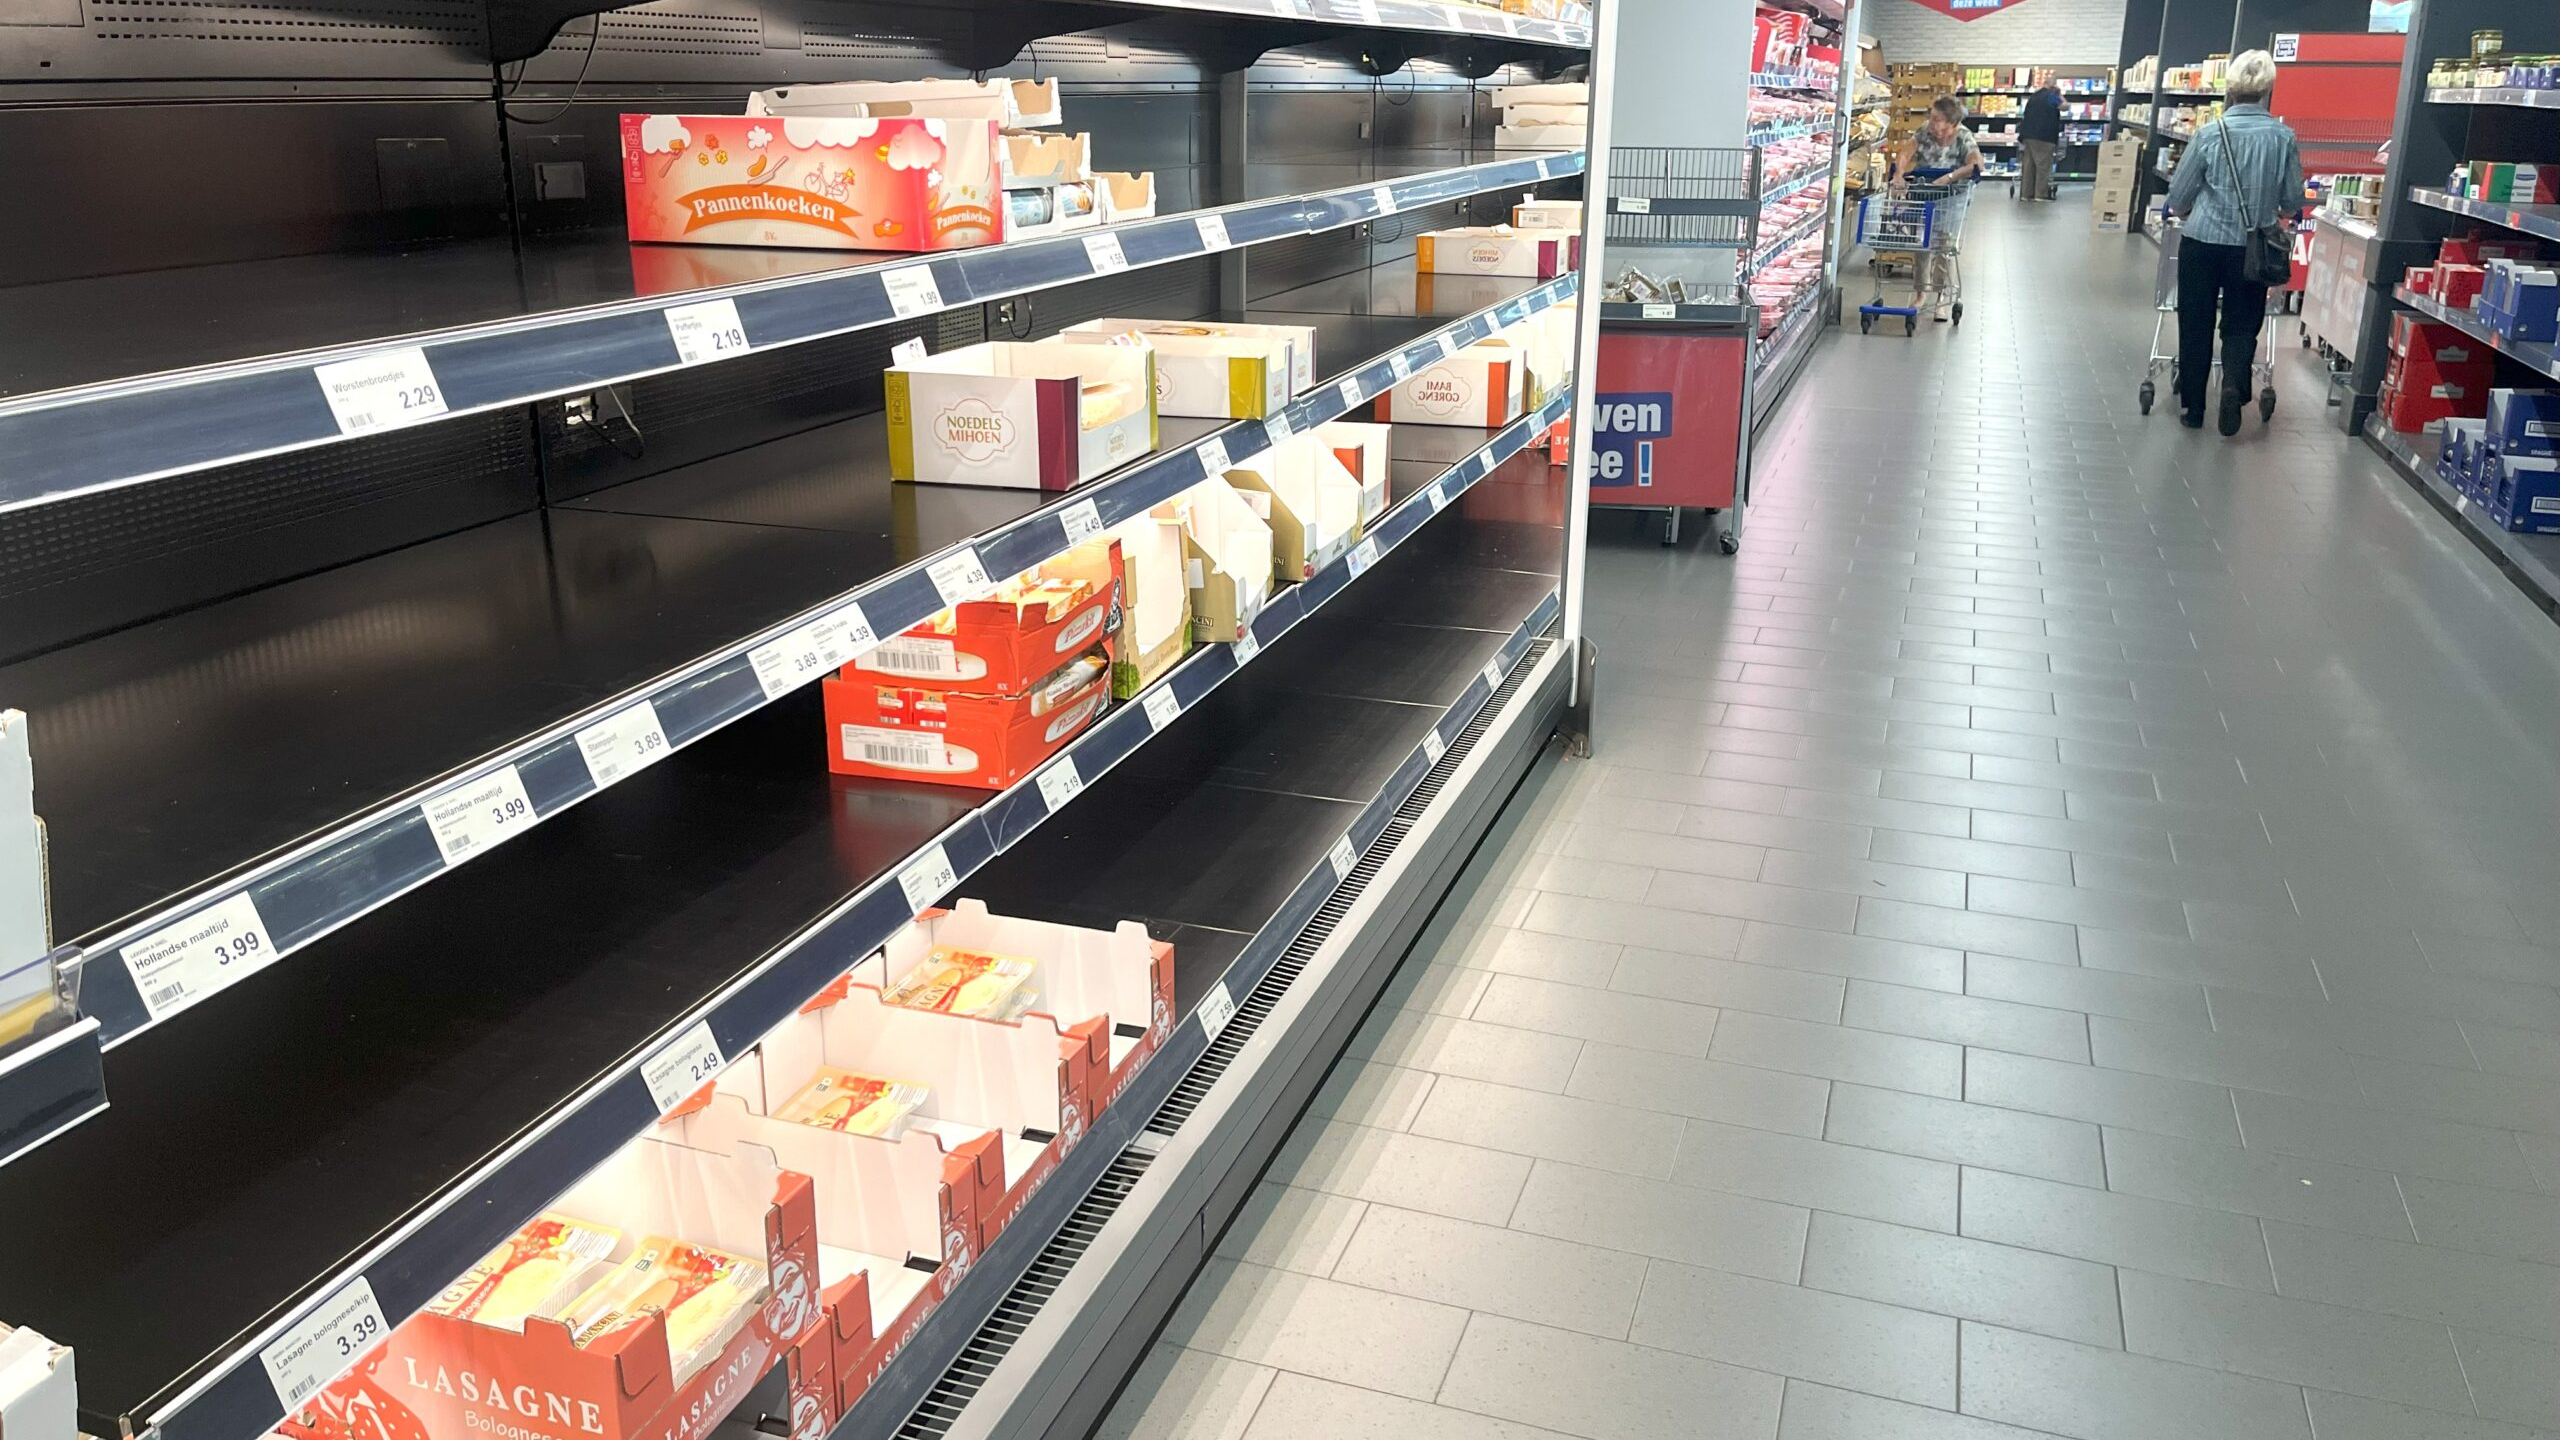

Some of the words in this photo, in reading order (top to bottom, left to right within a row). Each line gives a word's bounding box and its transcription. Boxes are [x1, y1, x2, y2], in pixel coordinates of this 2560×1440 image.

[693, 191, 835, 223] Pannenkoeken
[936, 209, 991, 231] Pannenkoeken
[712, 328, 742, 350] 2.19
[332, 370, 405, 394] Worstenbroodjes
[399, 385, 436, 409] 2.29
[947, 415, 1002, 431] NOEDELS
[1593, 402, 1662, 433] ven
[949, 429, 1001, 444] MIHOEN
[1085, 517, 1101, 533] 4.49
[966, 569, 984, 585] 4.39
[1191, 614, 1214, 627] NCINI
[850, 625, 869, 644] 4.39
[795, 652, 818, 672] 3.89
[634, 731, 662, 755] 3.89
[1064, 775, 1080, 795] 2.19
[434, 800, 473, 822] Hollandse
[473, 785, 503, 806] maaltijd
[492, 797, 525, 824] 3.99
[935, 867, 951, 888] 2.99
[134, 939, 188, 970] Hollandse
[189, 919, 230, 946] maaltijd
[215, 931, 260, 966] 3.99
[691, 1052, 718, 1082] 2.49
[425, 1266, 495, 1315] AGNE
[457, 1280, 495, 1320] olognese
[276, 1336, 313, 1371] Lasagne
[313, 1293, 370, 1341] bolognese/kip
[336, 1314, 377, 1356] 3.39
[404, 1356, 604, 1435] LASAGNE
[665, 1346, 752, 1440] LASAGNE
[465, 1410, 566, 1440] Bolognes
